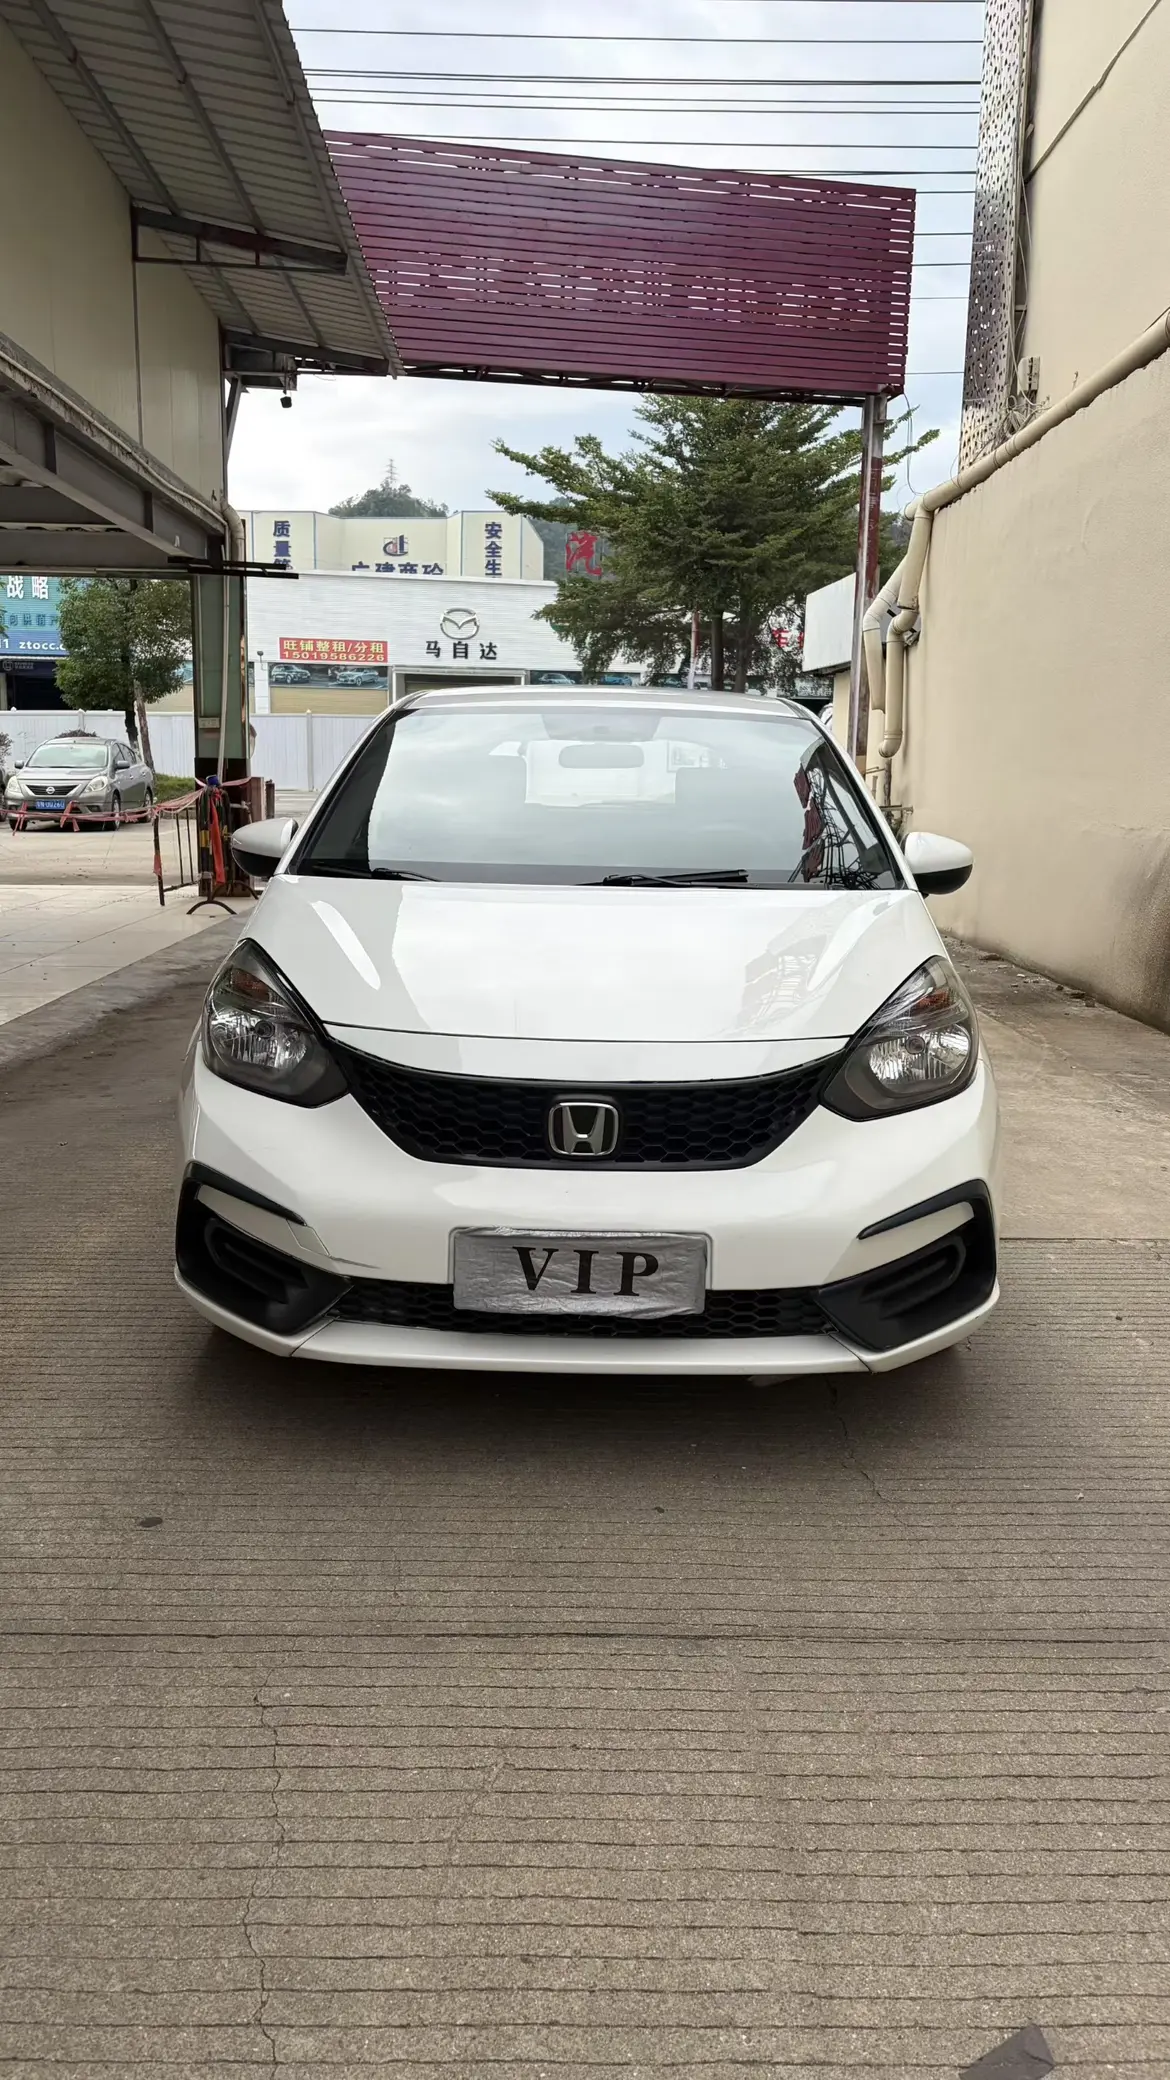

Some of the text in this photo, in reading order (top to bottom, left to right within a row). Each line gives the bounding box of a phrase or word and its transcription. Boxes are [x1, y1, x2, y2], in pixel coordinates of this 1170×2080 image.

[485, 521, 502, 577] 安全生
[6, 575, 49, 600] 战略
[283, 639, 384, 653] 旺铺整租/分租
[283, 650, 385, 662] 15019586226
[425, 640, 498, 660] 马自达
[512, 1246, 660, 1297] VIP
